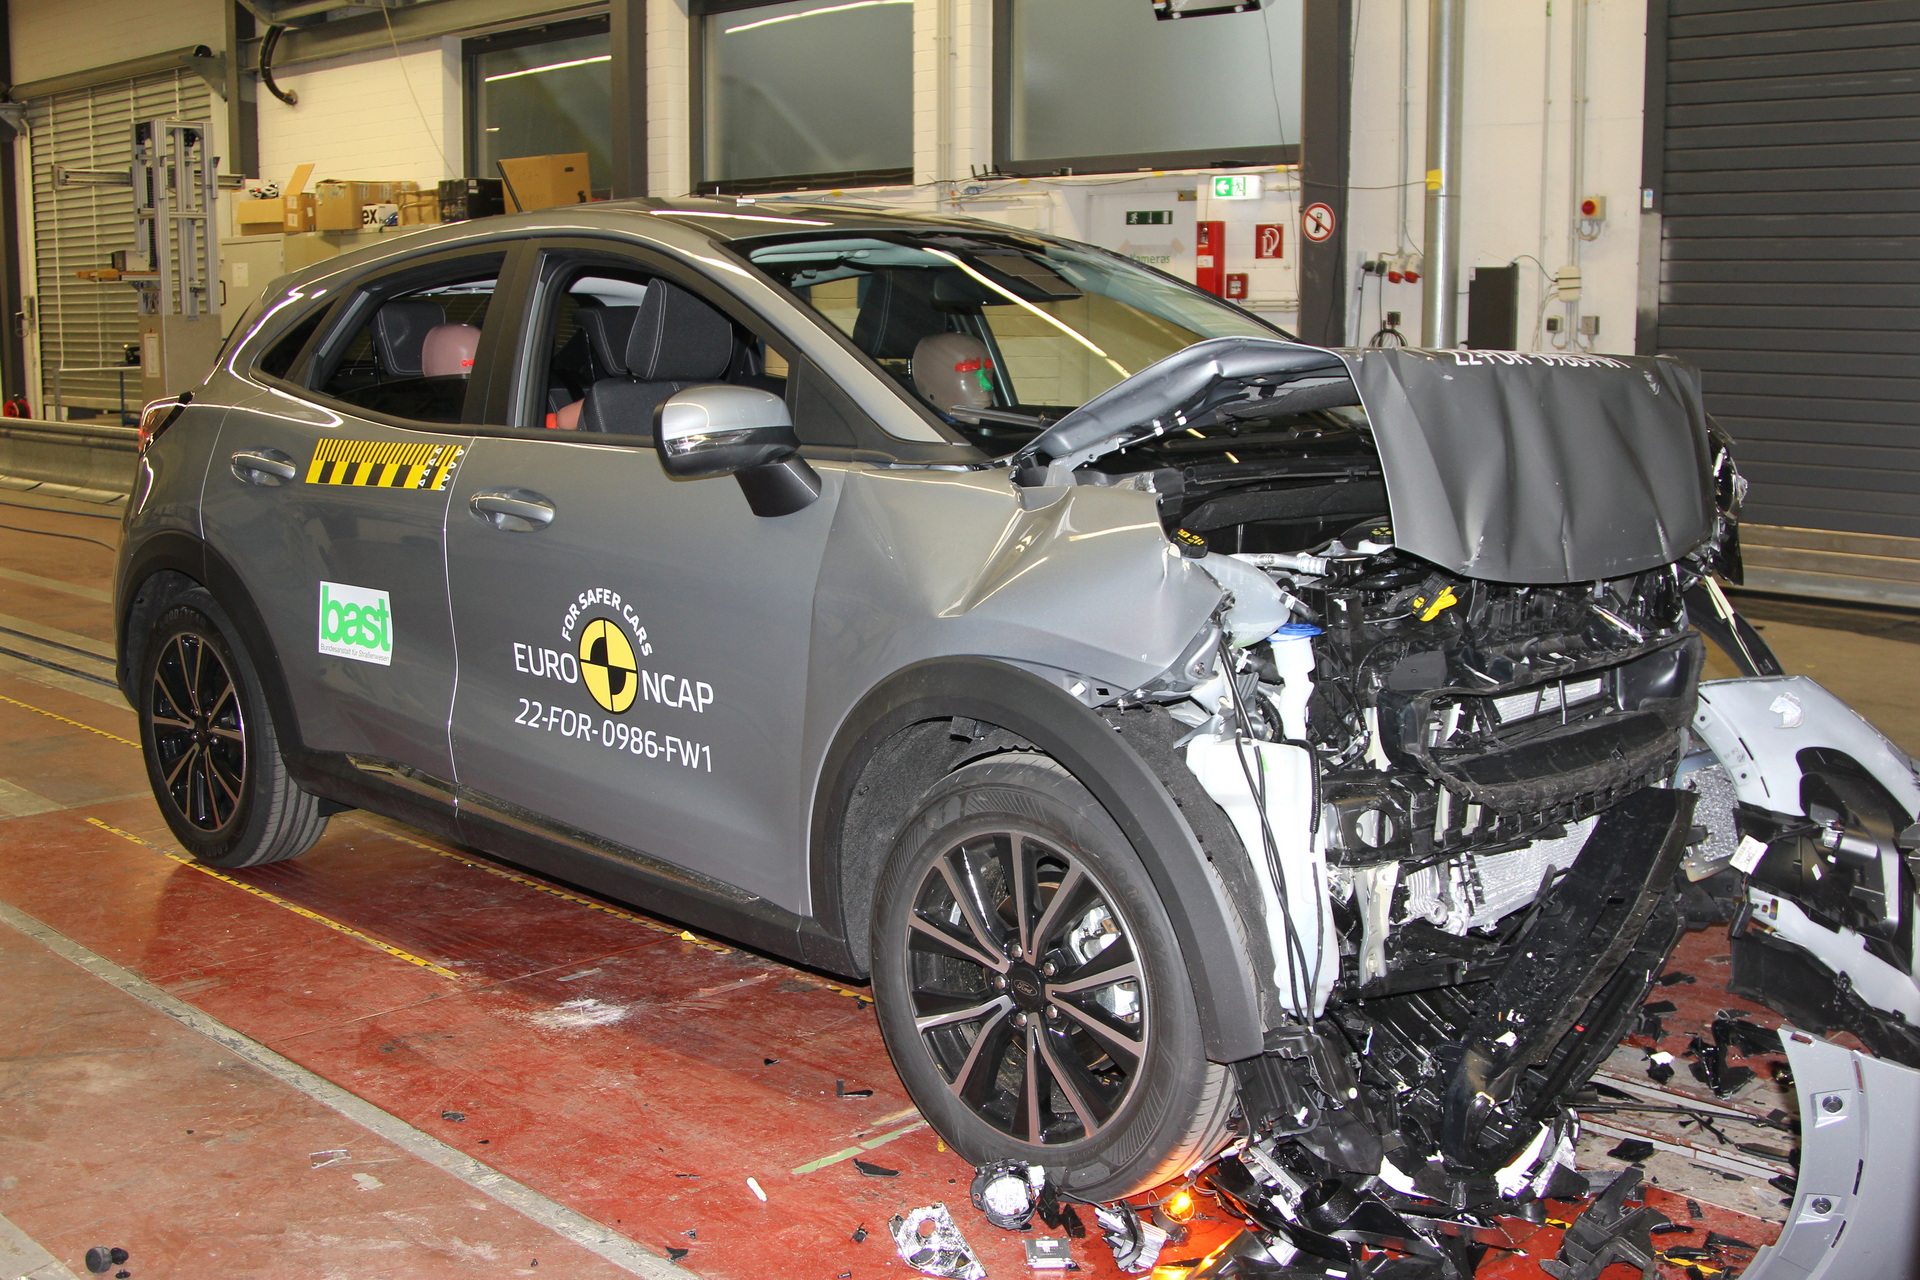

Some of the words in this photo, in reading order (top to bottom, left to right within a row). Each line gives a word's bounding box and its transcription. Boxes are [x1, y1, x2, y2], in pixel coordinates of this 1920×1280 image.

[321, 585, 390, 651] bast
[561, 603, 581, 642] FOR
[578, 587, 621, 611] SAFER
[623, 604, 653, 657] CARS
[513, 642, 579, 684] EURO
[642, 669, 714, 713] NCAP
[1017, 981, 1034, 994] Ford
